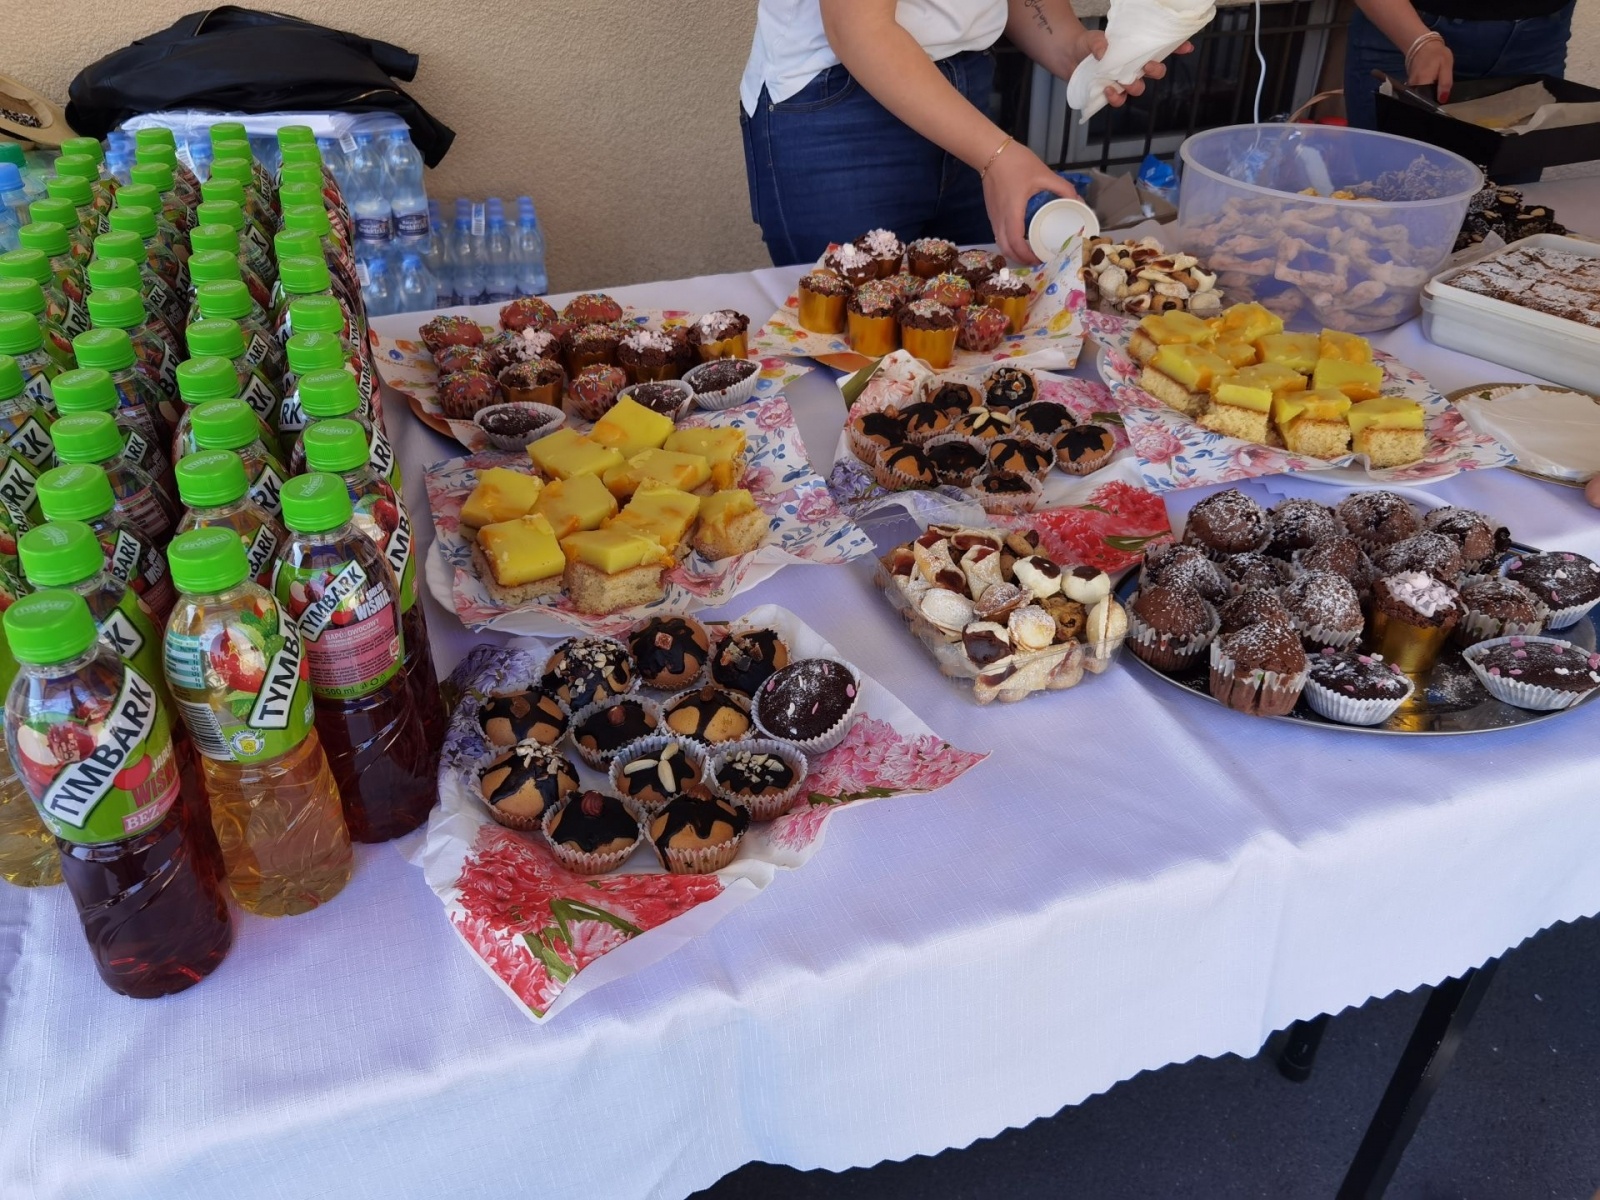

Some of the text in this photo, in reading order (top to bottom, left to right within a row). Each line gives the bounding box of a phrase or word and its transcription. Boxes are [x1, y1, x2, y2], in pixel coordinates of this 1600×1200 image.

[300, 566, 363, 636] TYMBARK
[258, 619, 300, 720] TYMBA
[50, 677, 152, 816] TYMBARK
[127, 805, 159, 831] BEZ
